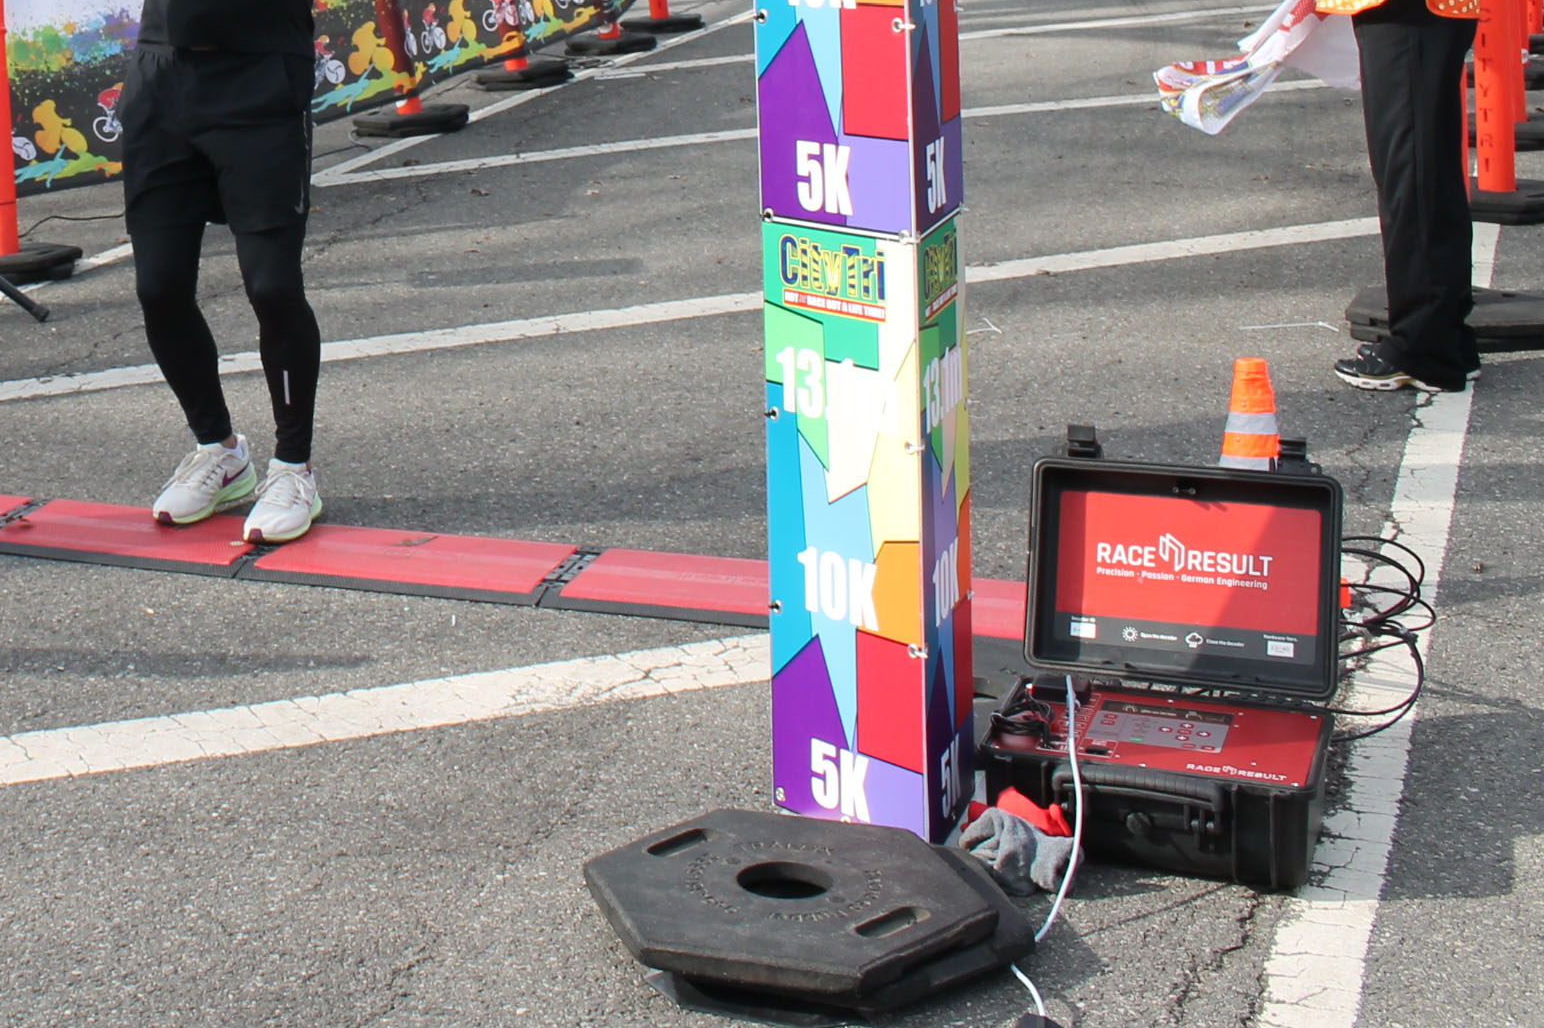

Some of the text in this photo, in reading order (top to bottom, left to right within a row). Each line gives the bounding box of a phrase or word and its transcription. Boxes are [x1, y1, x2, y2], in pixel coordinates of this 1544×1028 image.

[795, 138, 854, 217] 5K
[925, 135, 948, 215] 5K
[778, 233, 886, 302] CityTri
[796, 546, 880, 632] 10K
[932, 537, 959, 629] 10K
[1096, 542, 1273, 577] RACE RESULT
[1096, 566, 1268, 590] Precision Passion German Engineering
[809, 737, 872, 824] 5K
[940, 732, 960, 820] 5K
[1186, 763, 1287, 782] RACE RESULT
